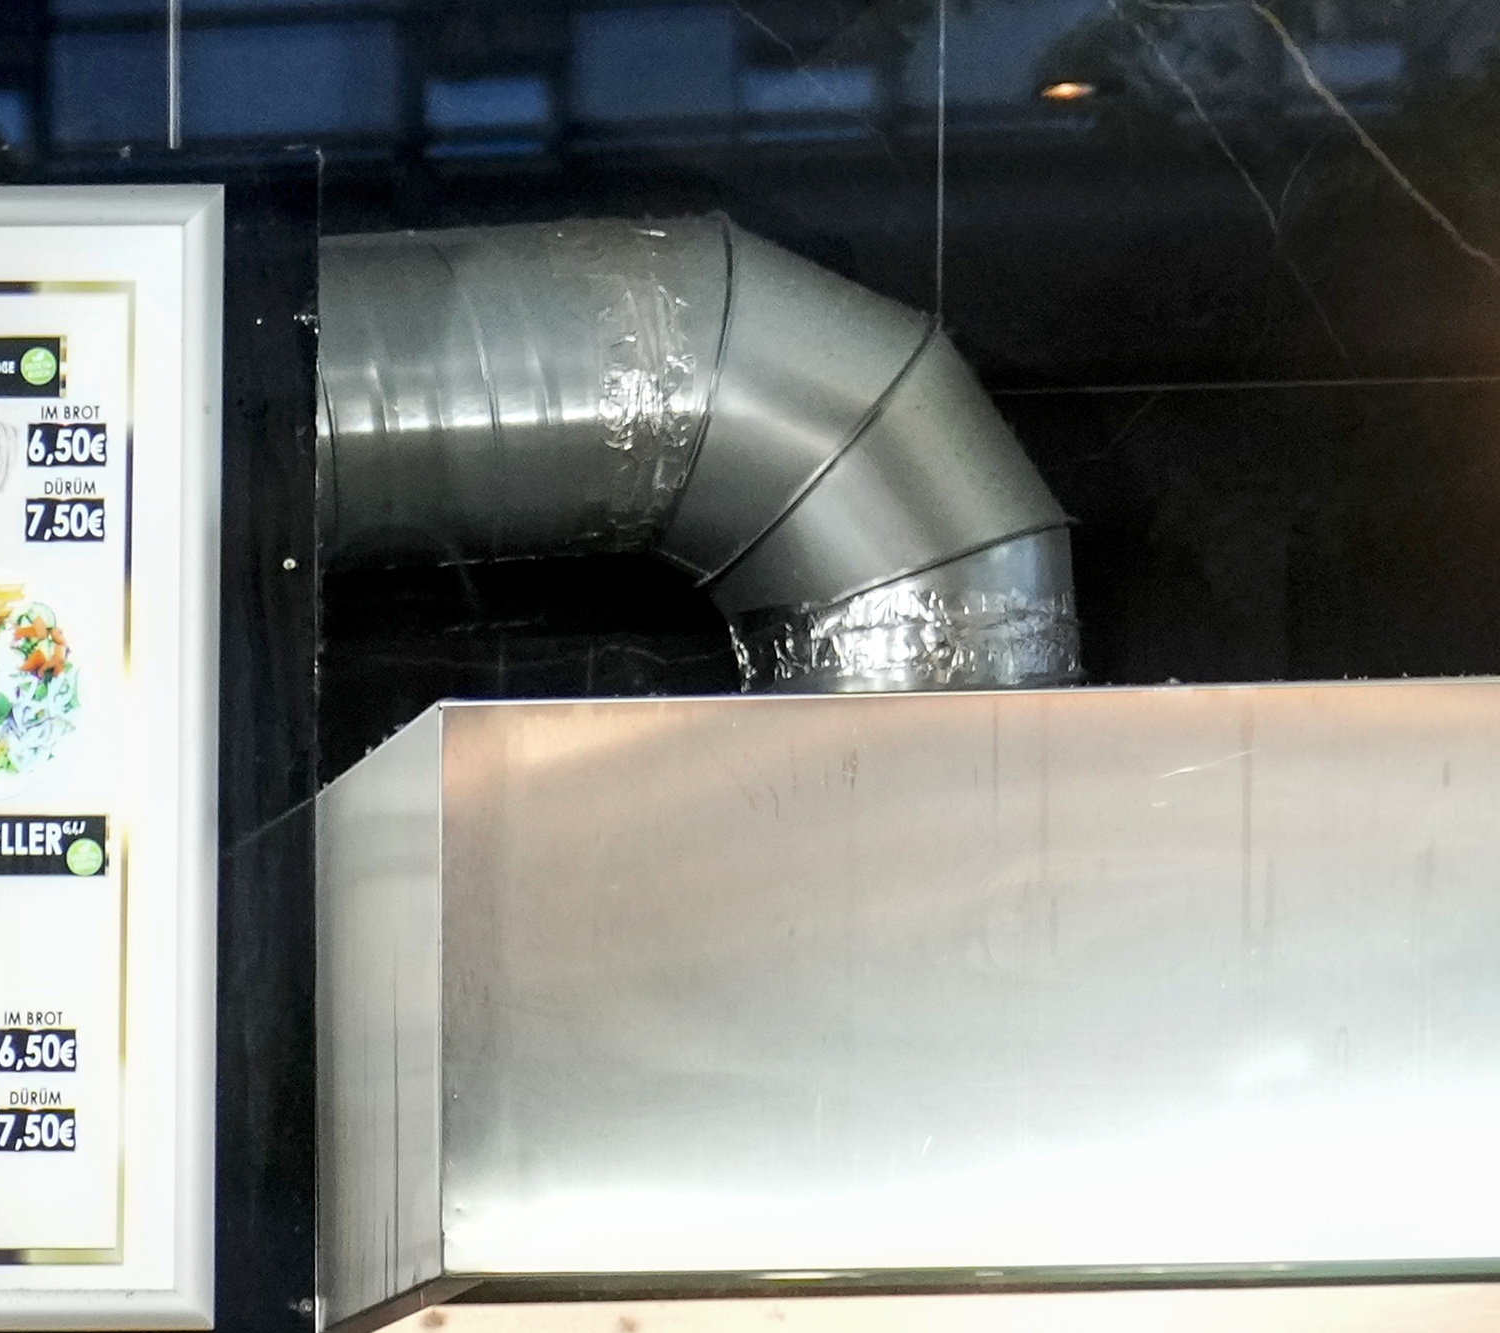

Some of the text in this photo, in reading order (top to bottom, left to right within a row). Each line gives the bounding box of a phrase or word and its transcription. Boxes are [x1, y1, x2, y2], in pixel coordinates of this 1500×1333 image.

[40, 406, 99, 421] IM BROT
[29, 429, 105, 464] 6,50€
[44, 478, 97, 496] DÜRÜM
[27, 504, 103, 539] 7,50€
[3, 1011, 62, 1027] IM BROT
[0, 1034, 75, 1070] 6,50€
[9, 1089, 62, 1106] DÜRÜM
